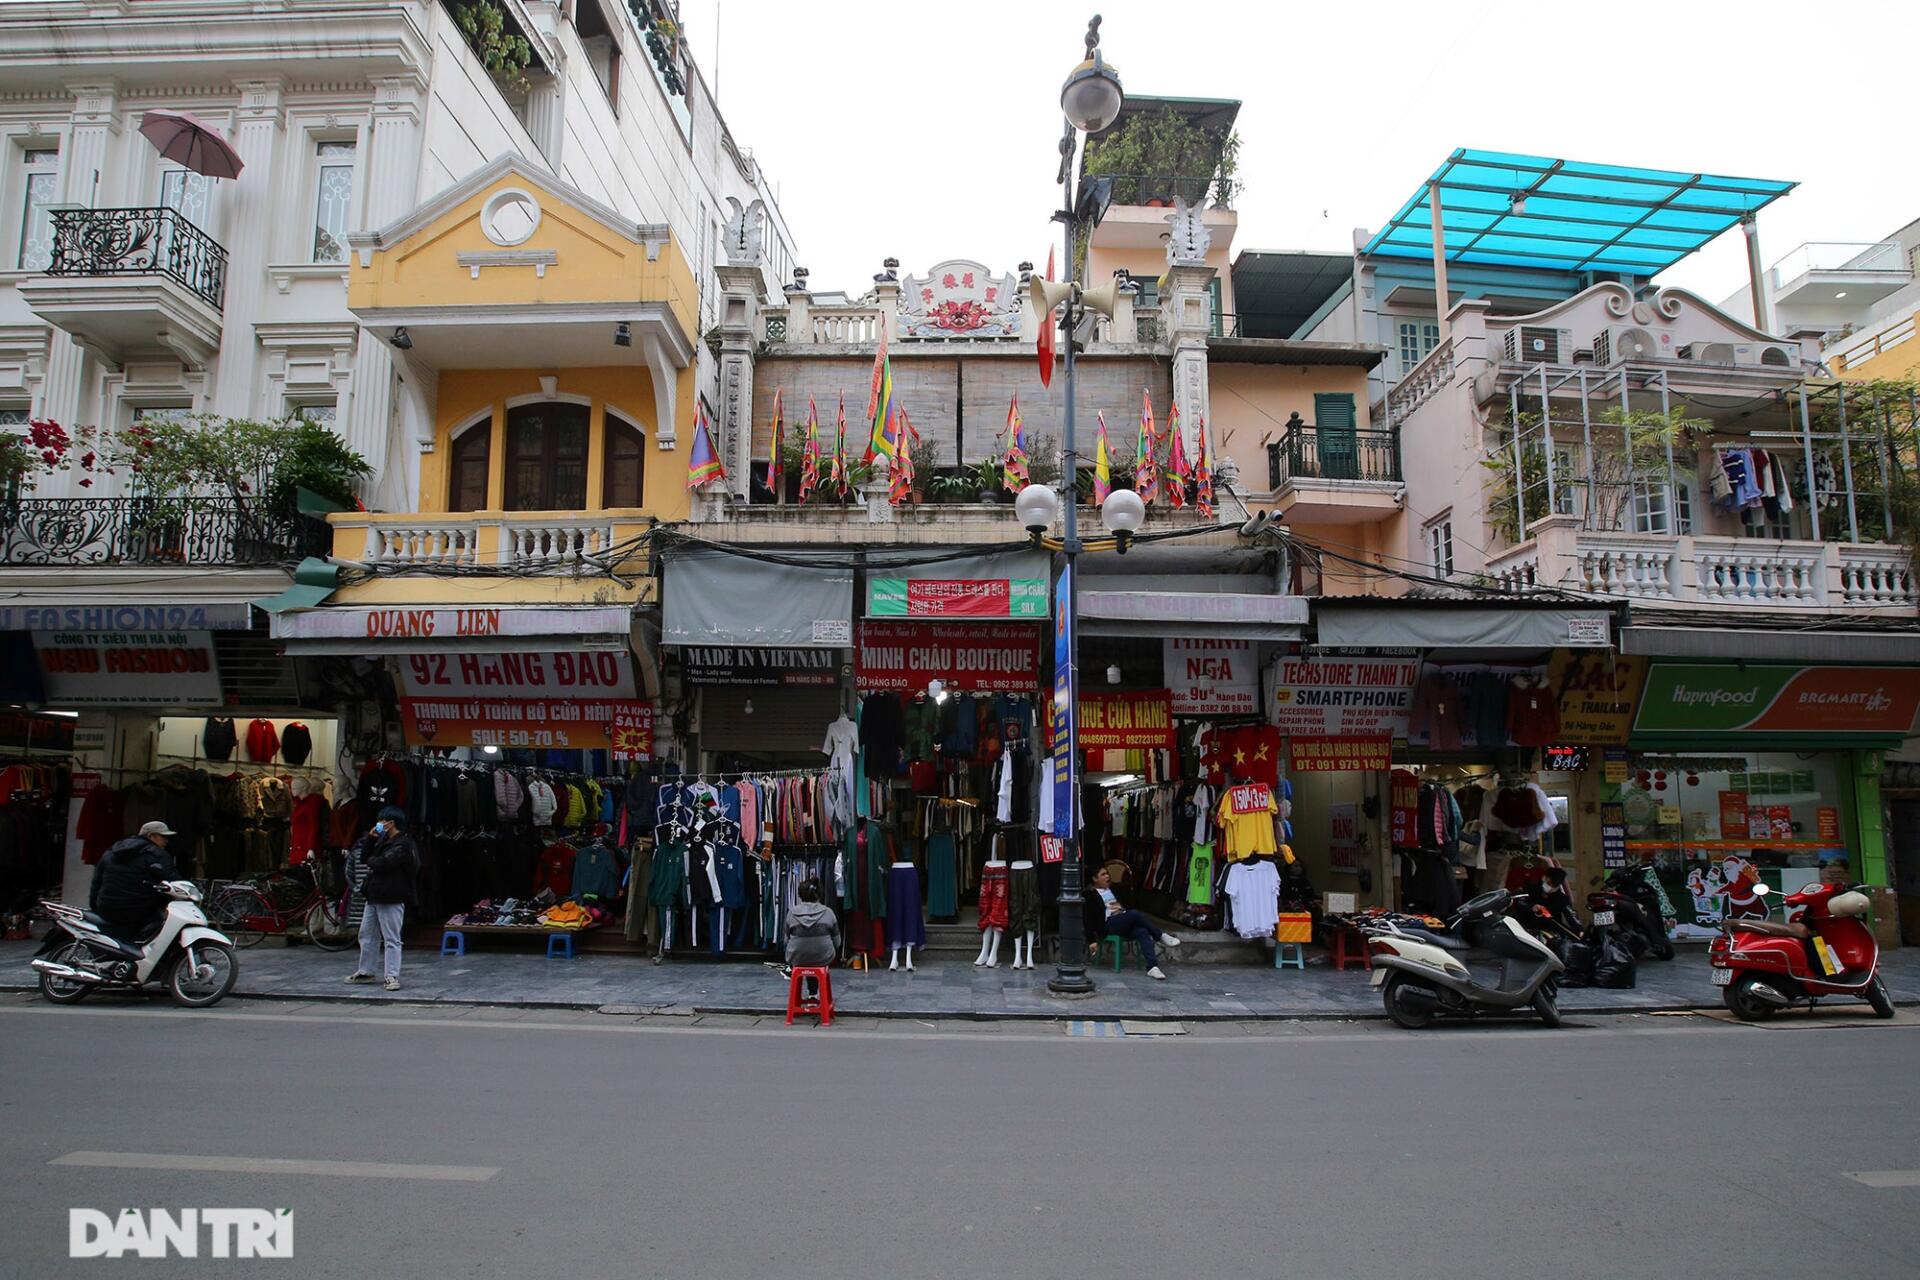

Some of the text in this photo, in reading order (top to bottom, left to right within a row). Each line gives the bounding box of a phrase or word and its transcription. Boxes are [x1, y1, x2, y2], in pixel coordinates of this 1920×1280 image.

[1021, 602, 1035, 614] SILK
[366, 608, 501, 638] QUANG LIEN
[54, 631, 188, 647] CÔNG TY SIÊU THỊ HÀ NỘI
[104, 648, 210, 673] FASHION
[688, 648, 833, 668] MADE IN VIETNAM
[862, 642, 1032, 673] MINH CHÂU BOUTIQUE
[410, 653, 450, 686] 92
[1186, 658, 1232, 680] NGA
[1283, 661, 1416, 686] TECHSTORE THANH TÚ
[856, 676, 868, 687] 90
[868, 676, 890, 688] HÀNG
[976, 680, 992, 688] TEL:
[1296, 690, 1408, 706] SMARTPHONE
[1799, 692, 1866, 704] BRGMART
[412, 700, 613, 725] THANH LÝ TOÀN BỘ CỬA HÀN
[631, 706, 652, 717] KHO
[1135, 694, 1168, 730] HÀNG
[1280, 708, 1324, 716] ACCESSORIES
[1580, 701, 1632, 714] THAILAND
[615, 716, 650, 728] SALE
[471, 730, 569, 746] SALE 50-70 %
[1316, 760, 1336, 770] 091
[1339, 760, 1360, 770] 979
[1364, 759, 1386, 770] 1499
